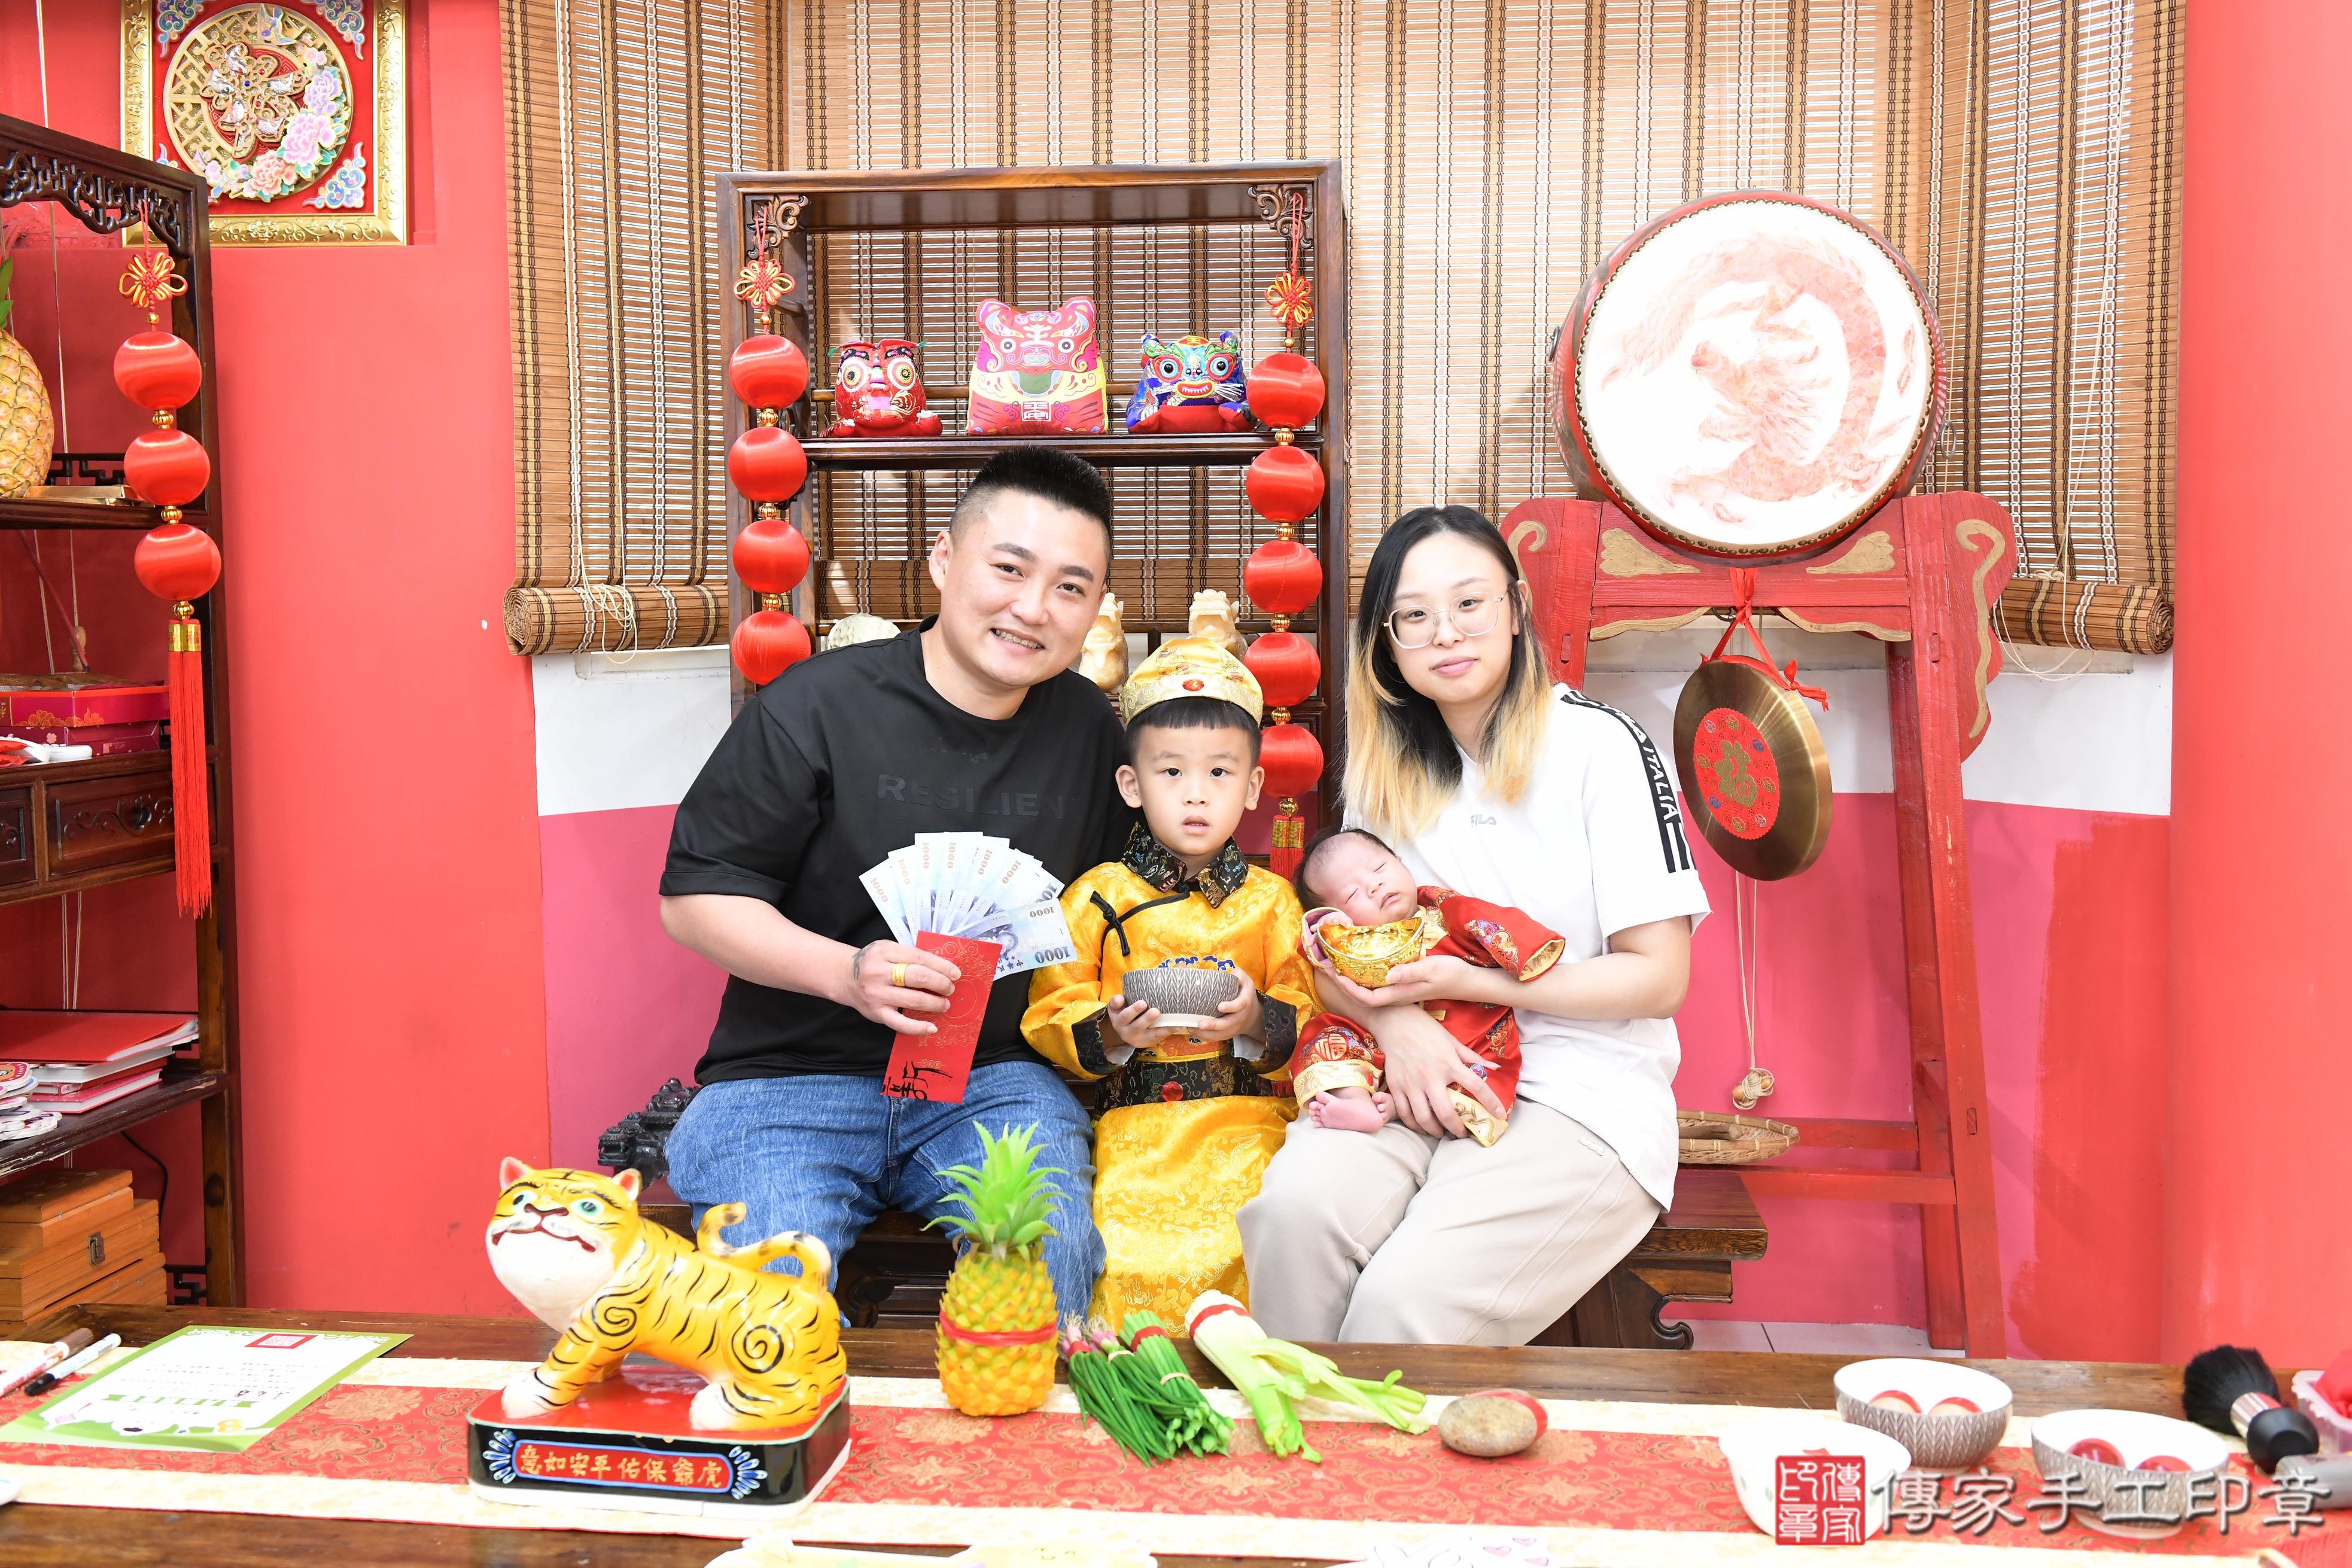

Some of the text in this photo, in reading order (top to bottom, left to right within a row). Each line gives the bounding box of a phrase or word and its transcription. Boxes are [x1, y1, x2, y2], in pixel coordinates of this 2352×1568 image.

[1020, 324, 1055, 348] 王
[1642, 746, 1678, 821] ITALIA
[947, 842, 956, 869] 1000
[978, 848, 993, 875] 1000
[898, 859, 911, 885] 1000
[1002, 860, 1022, 884] 1000
[870, 878, 888, 902] 1000
[1029, 906, 1055, 918] 1000
[1034, 946, 1070, 963] 1000
[1315, 1033, 1347, 1061] 福
